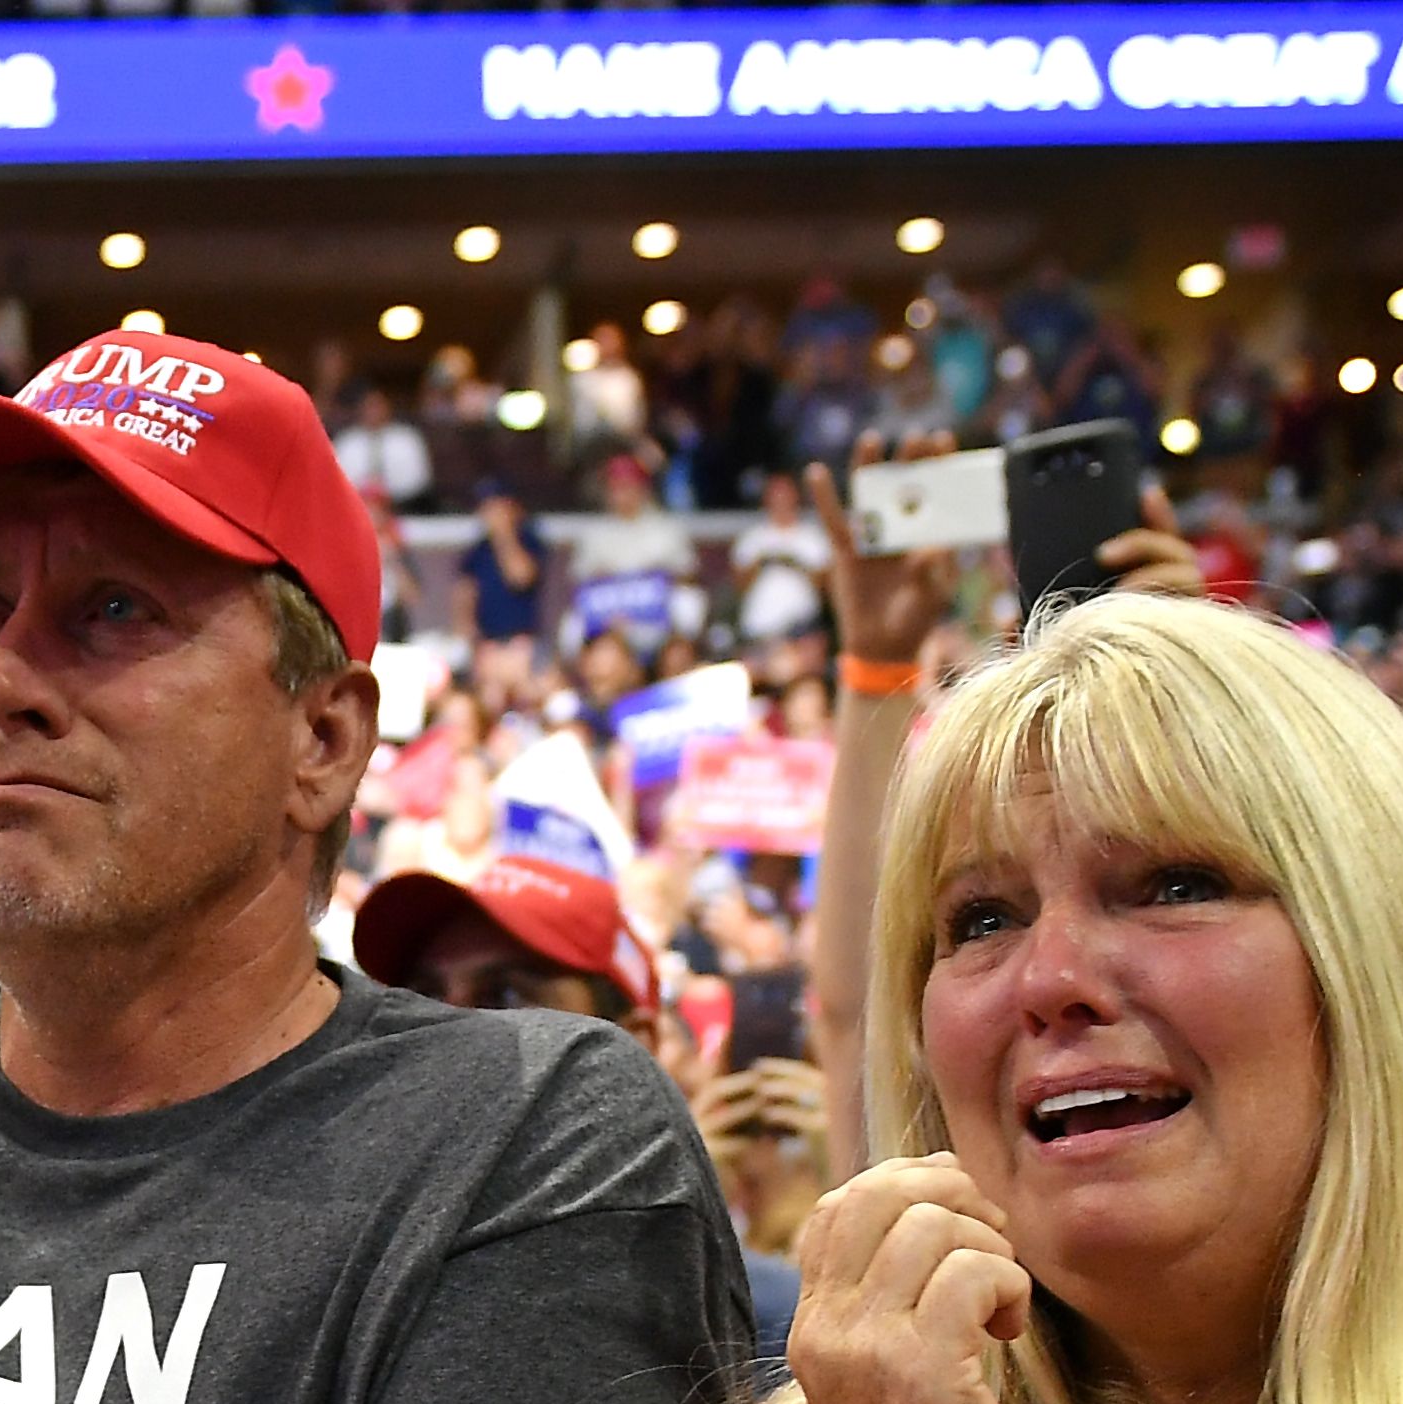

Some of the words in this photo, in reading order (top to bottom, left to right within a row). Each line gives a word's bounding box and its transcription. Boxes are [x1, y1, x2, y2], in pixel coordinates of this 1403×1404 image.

[482, 42, 720, 118] MAKE
[729, 37, 1101, 114] AMERICA
[1109, 32, 1378, 108] GREAT
[113, 411, 197, 456] GREAT
